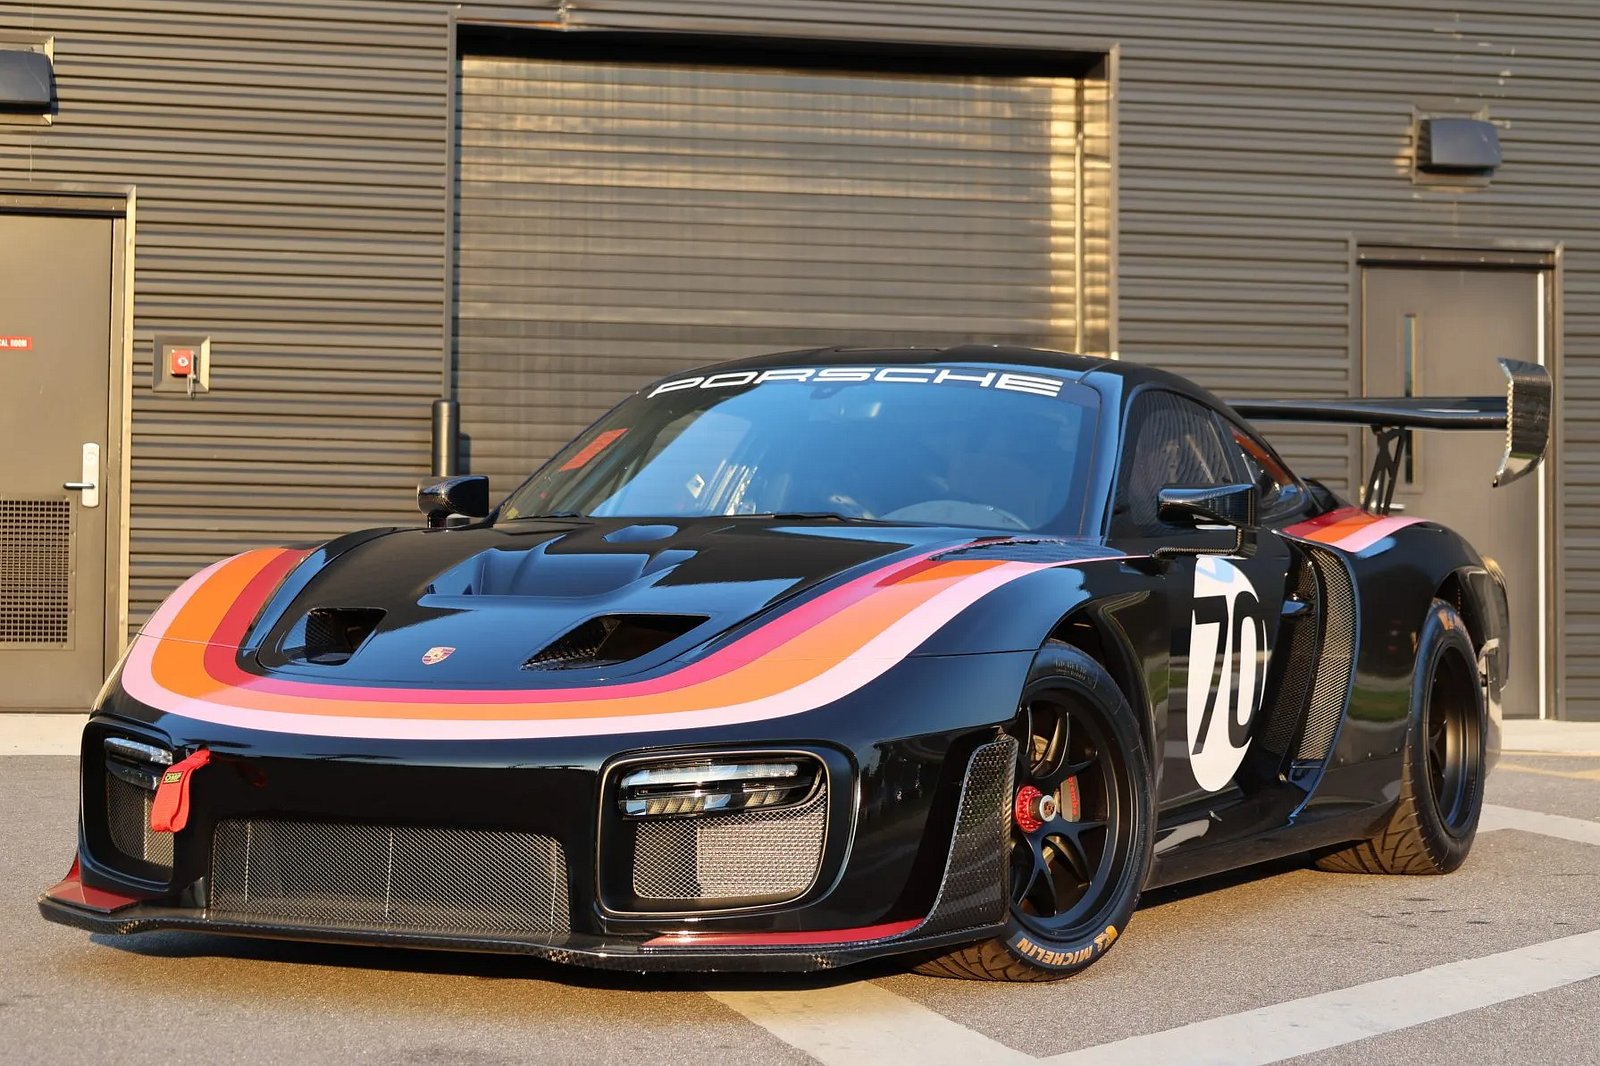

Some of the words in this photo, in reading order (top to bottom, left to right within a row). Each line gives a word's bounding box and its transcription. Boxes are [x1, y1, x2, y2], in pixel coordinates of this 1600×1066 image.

[647, 367, 1064, 398] PORSCHE
[1191, 591, 1263, 755] 70
[1016, 937, 1093, 966] MICHELIN
